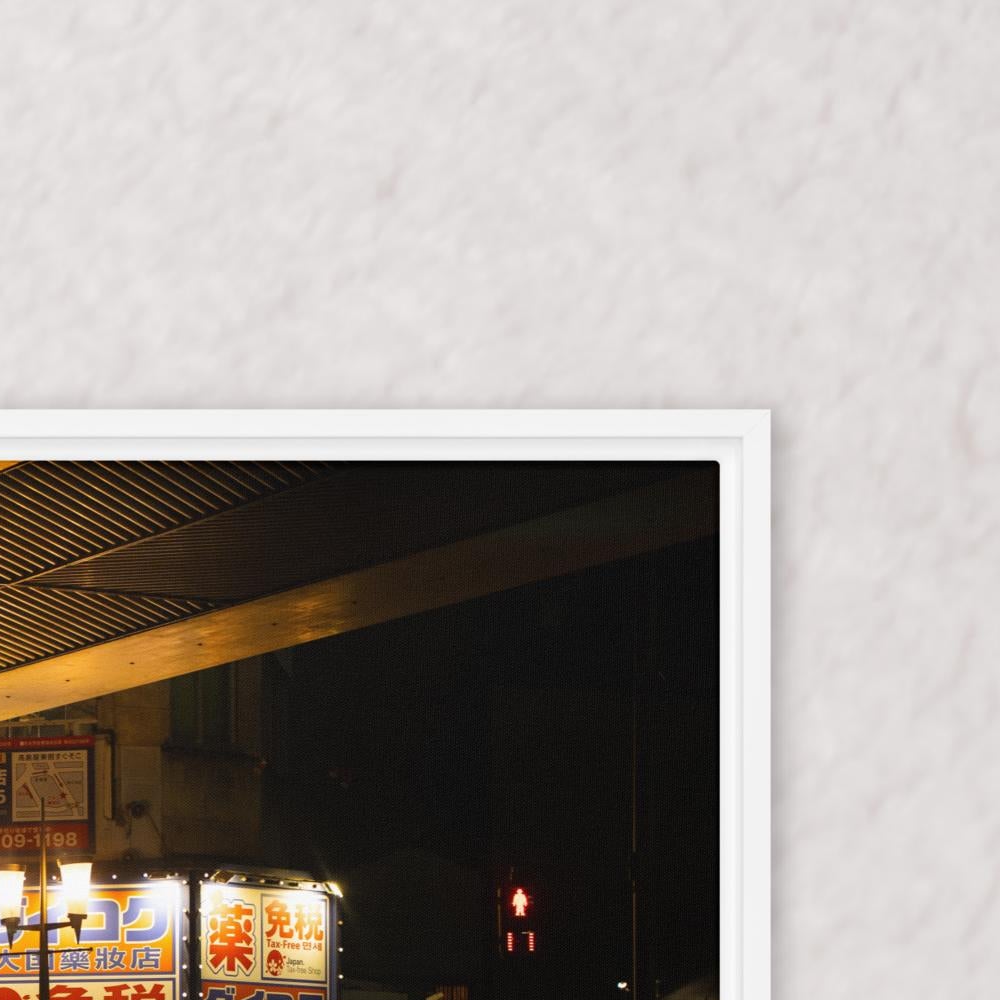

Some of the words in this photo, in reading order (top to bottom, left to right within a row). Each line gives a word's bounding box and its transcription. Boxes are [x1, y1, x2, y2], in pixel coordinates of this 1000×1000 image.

[208, 902, 253, 973] 薬
[264, 899, 324, 941] 免税
[266, 938, 301, 950] Tax-Free
